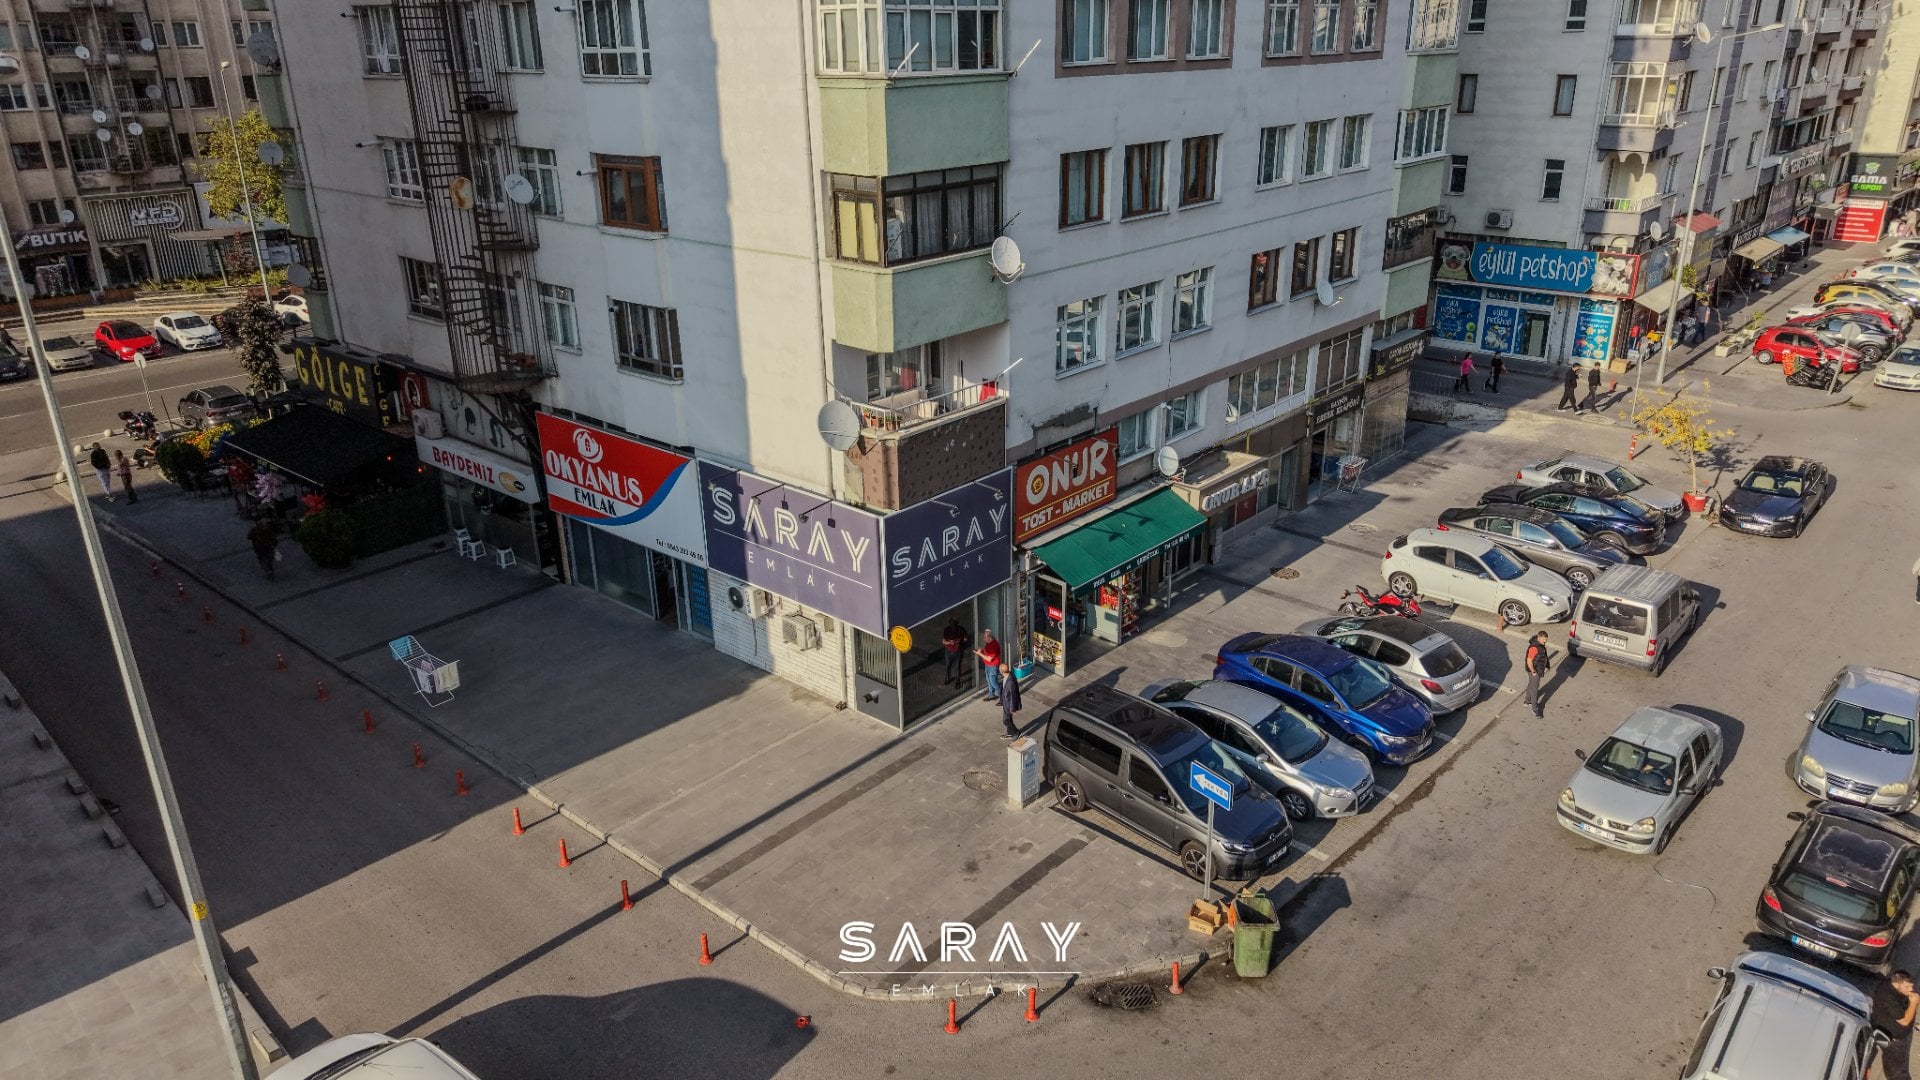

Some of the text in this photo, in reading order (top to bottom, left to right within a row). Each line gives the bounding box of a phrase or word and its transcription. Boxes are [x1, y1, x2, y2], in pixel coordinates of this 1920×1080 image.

[1479, 250, 1588, 287] eylül petshop
[294, 345, 369, 406] GÖLGE
[545, 449, 643, 506] OKYANUS
[1026, 439, 1109, 504] ONUR
[574, 487, 617, 516] EMLAK
[1023, 506, 1053, 532] TOST
[1063, 481, 1110, 515] MARKET
[712, 486, 871, 574] SARAY
[892, 502, 1008, 579] SARAY
[748, 551, 837, 595] EMLAK
[919, 553, 984, 591] EMLAK
